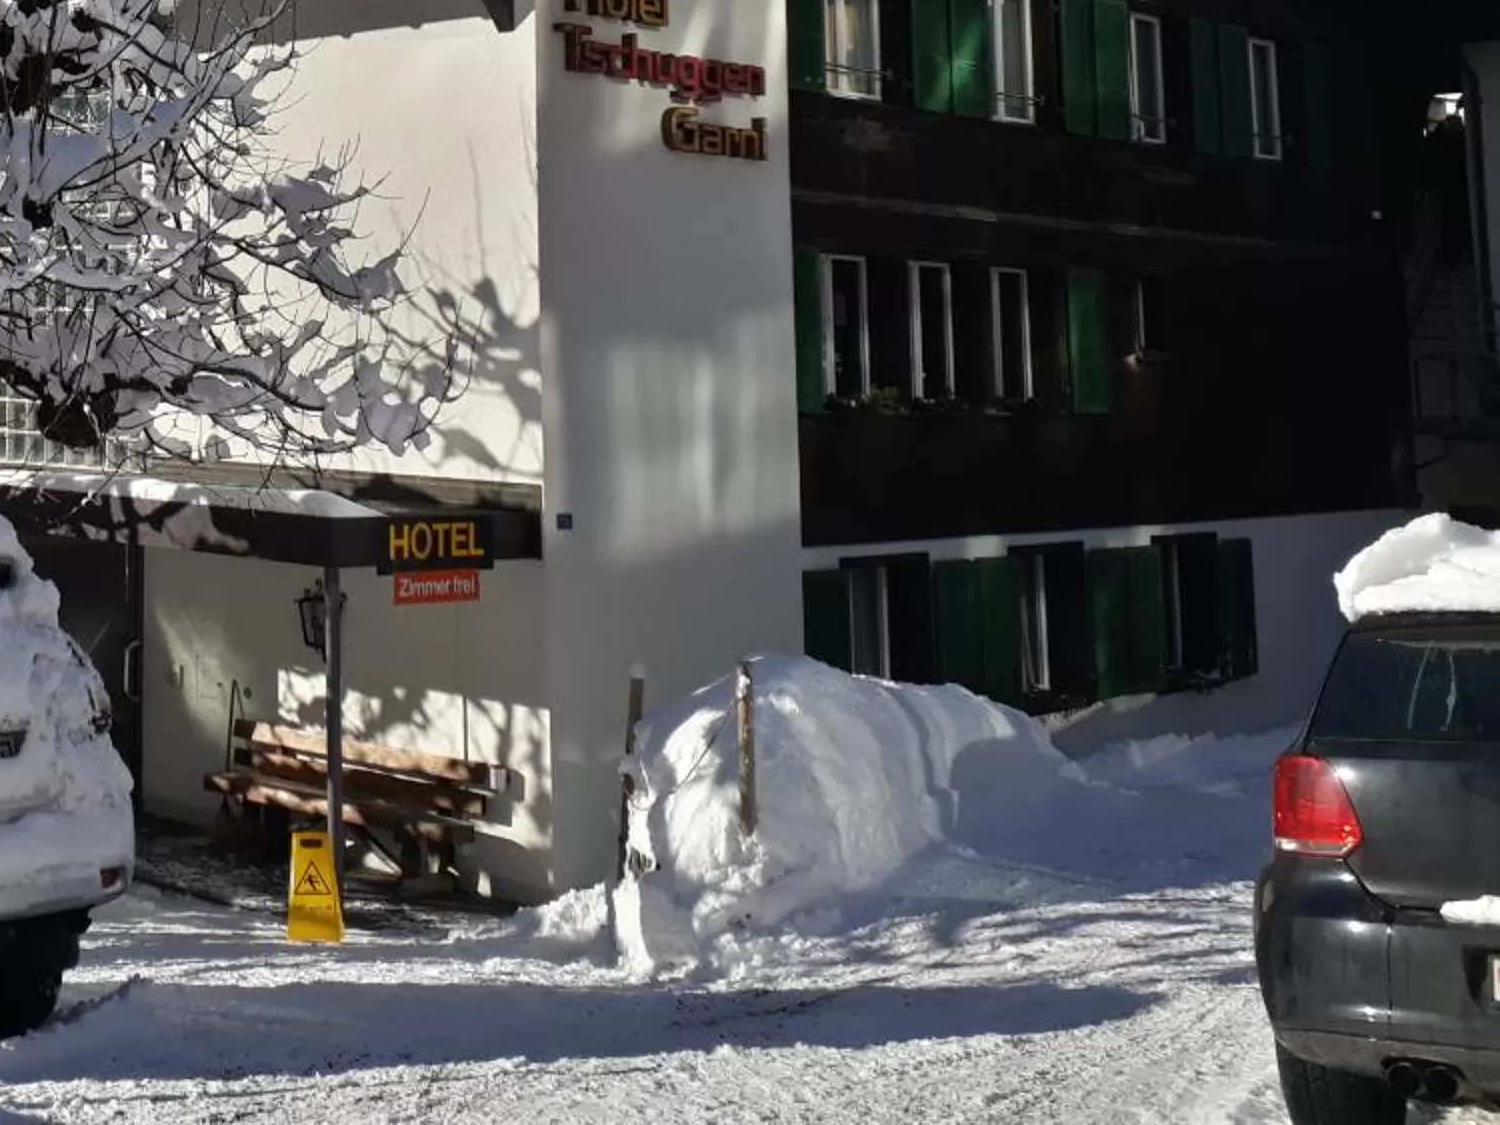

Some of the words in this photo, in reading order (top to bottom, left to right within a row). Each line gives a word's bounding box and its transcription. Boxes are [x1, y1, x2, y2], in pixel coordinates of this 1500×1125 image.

[553, 23, 766, 103] Tschuggen
[661, 106, 768, 160] Garni
[389, 522, 484, 560] HOTEL
[399, 578, 450, 597] Zimmer
